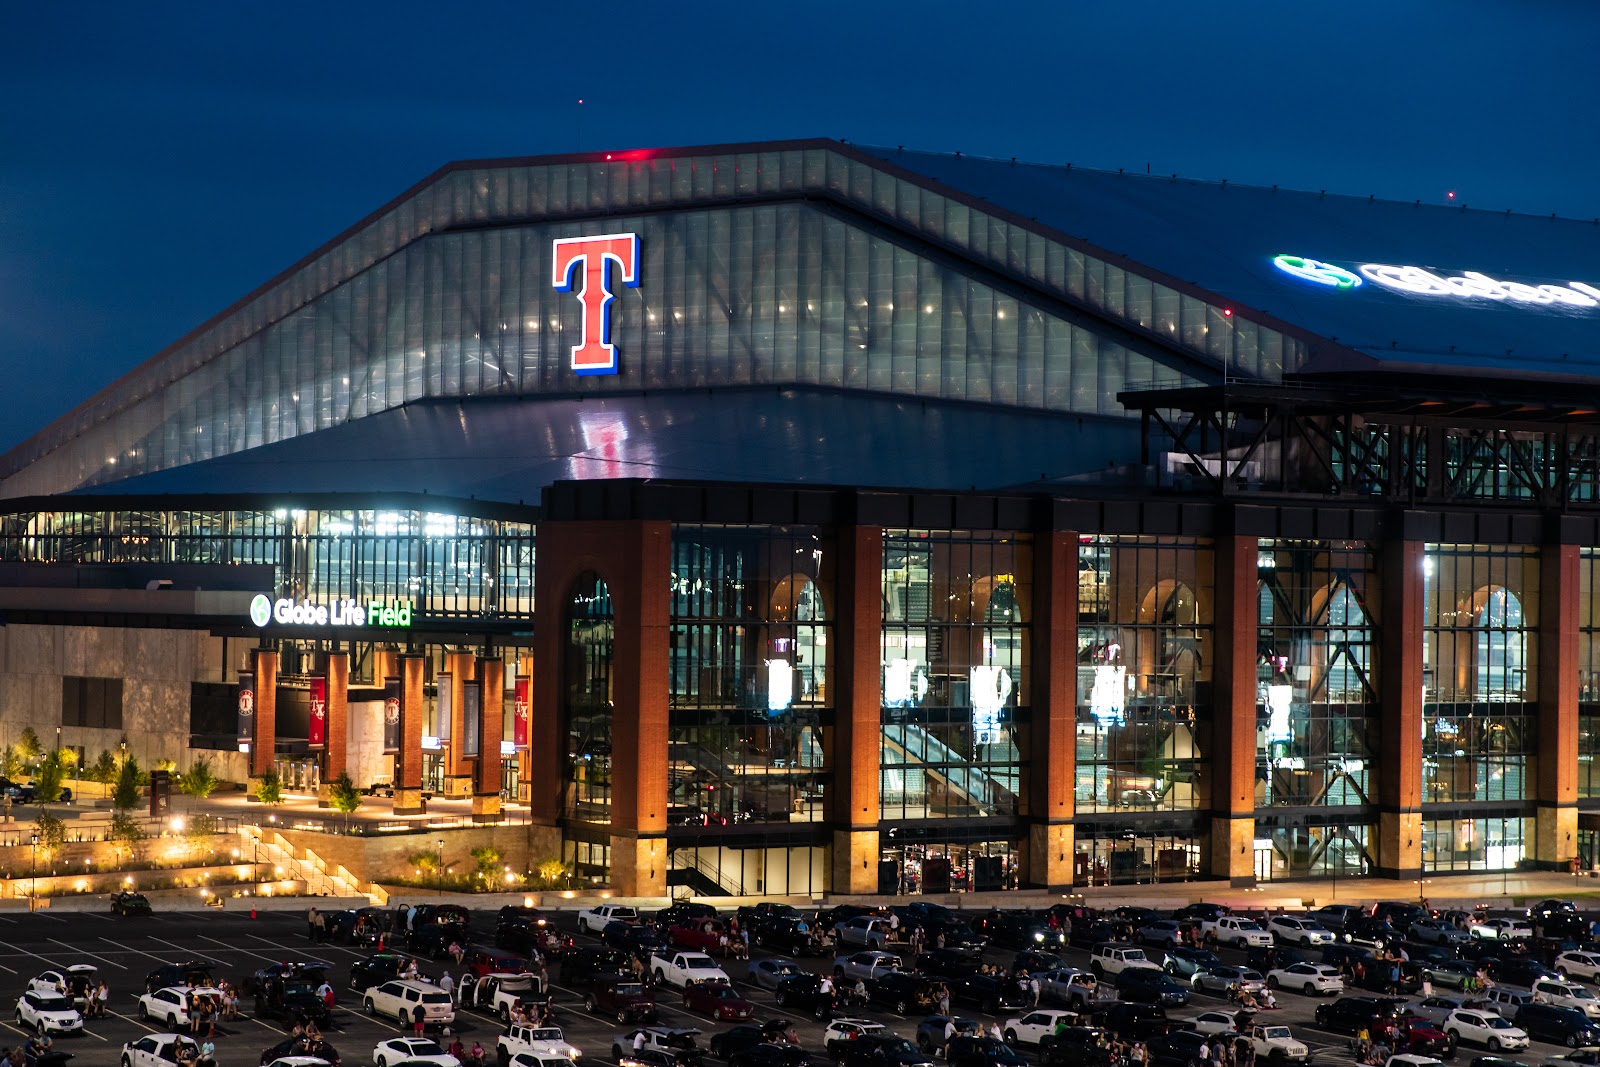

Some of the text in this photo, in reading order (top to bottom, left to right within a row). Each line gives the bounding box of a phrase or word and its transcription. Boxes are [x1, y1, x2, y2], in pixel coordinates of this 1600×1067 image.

[552, 233, 640, 376] T
[274, 598, 412, 627] Globe Life Field
